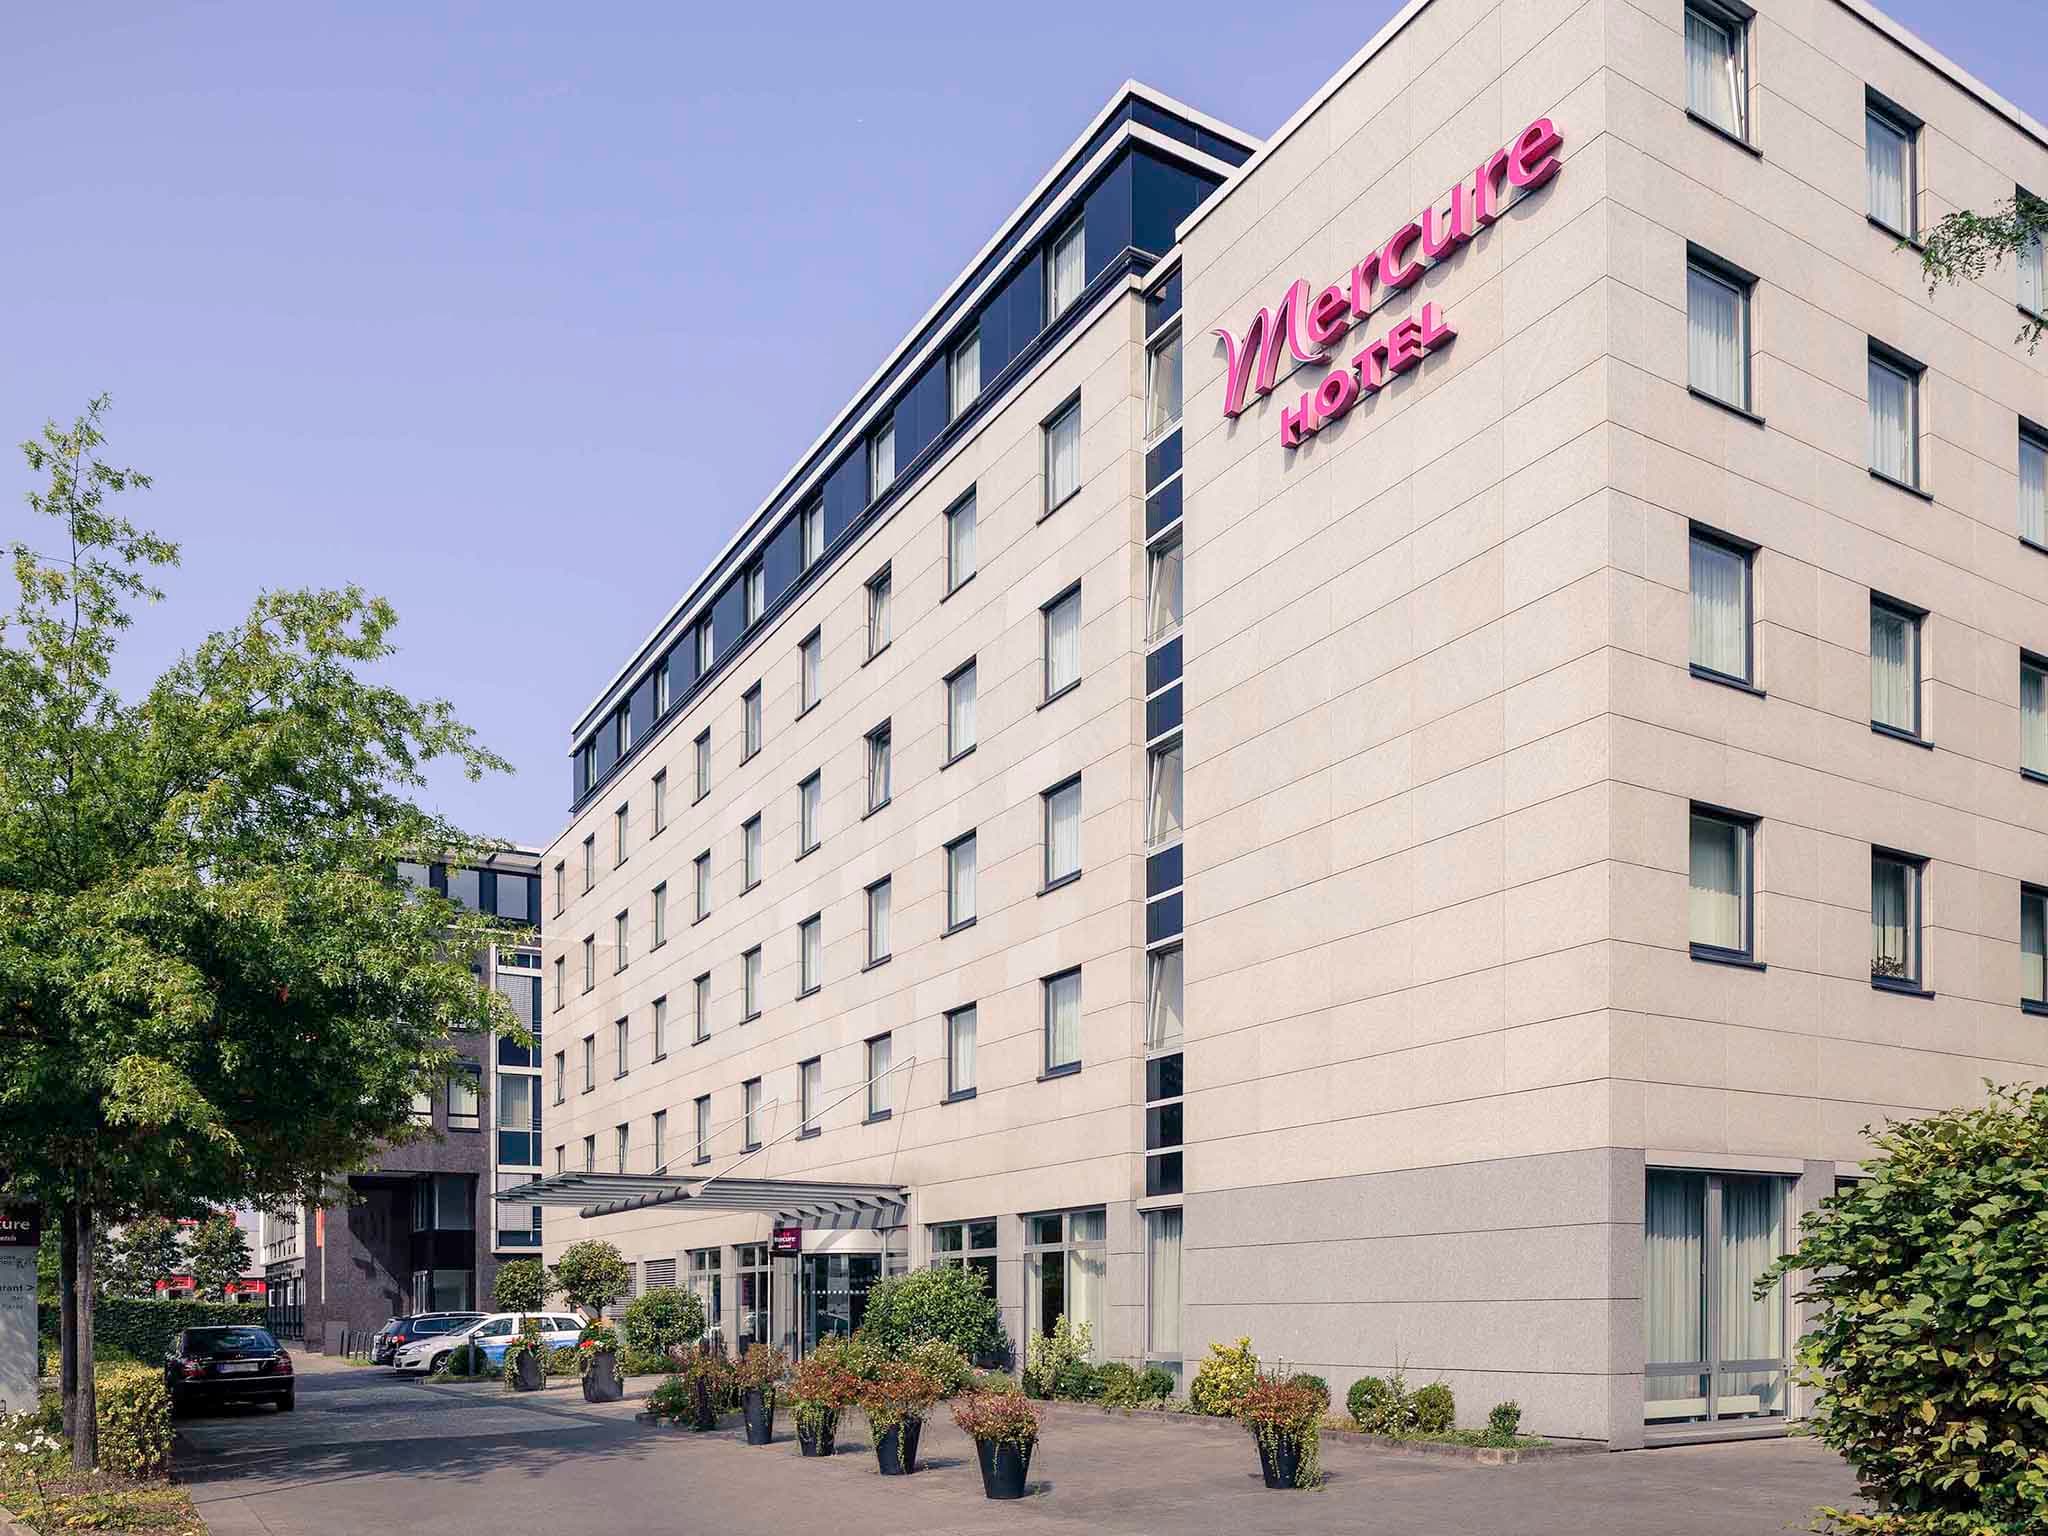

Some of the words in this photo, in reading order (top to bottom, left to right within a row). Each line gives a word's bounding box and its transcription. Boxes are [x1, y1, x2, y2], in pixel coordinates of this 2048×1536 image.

[1209, 118, 1563, 418] Mercure
[1281, 301, 1457, 448] HOTEL
[0, 1221, 31, 1230] ure
